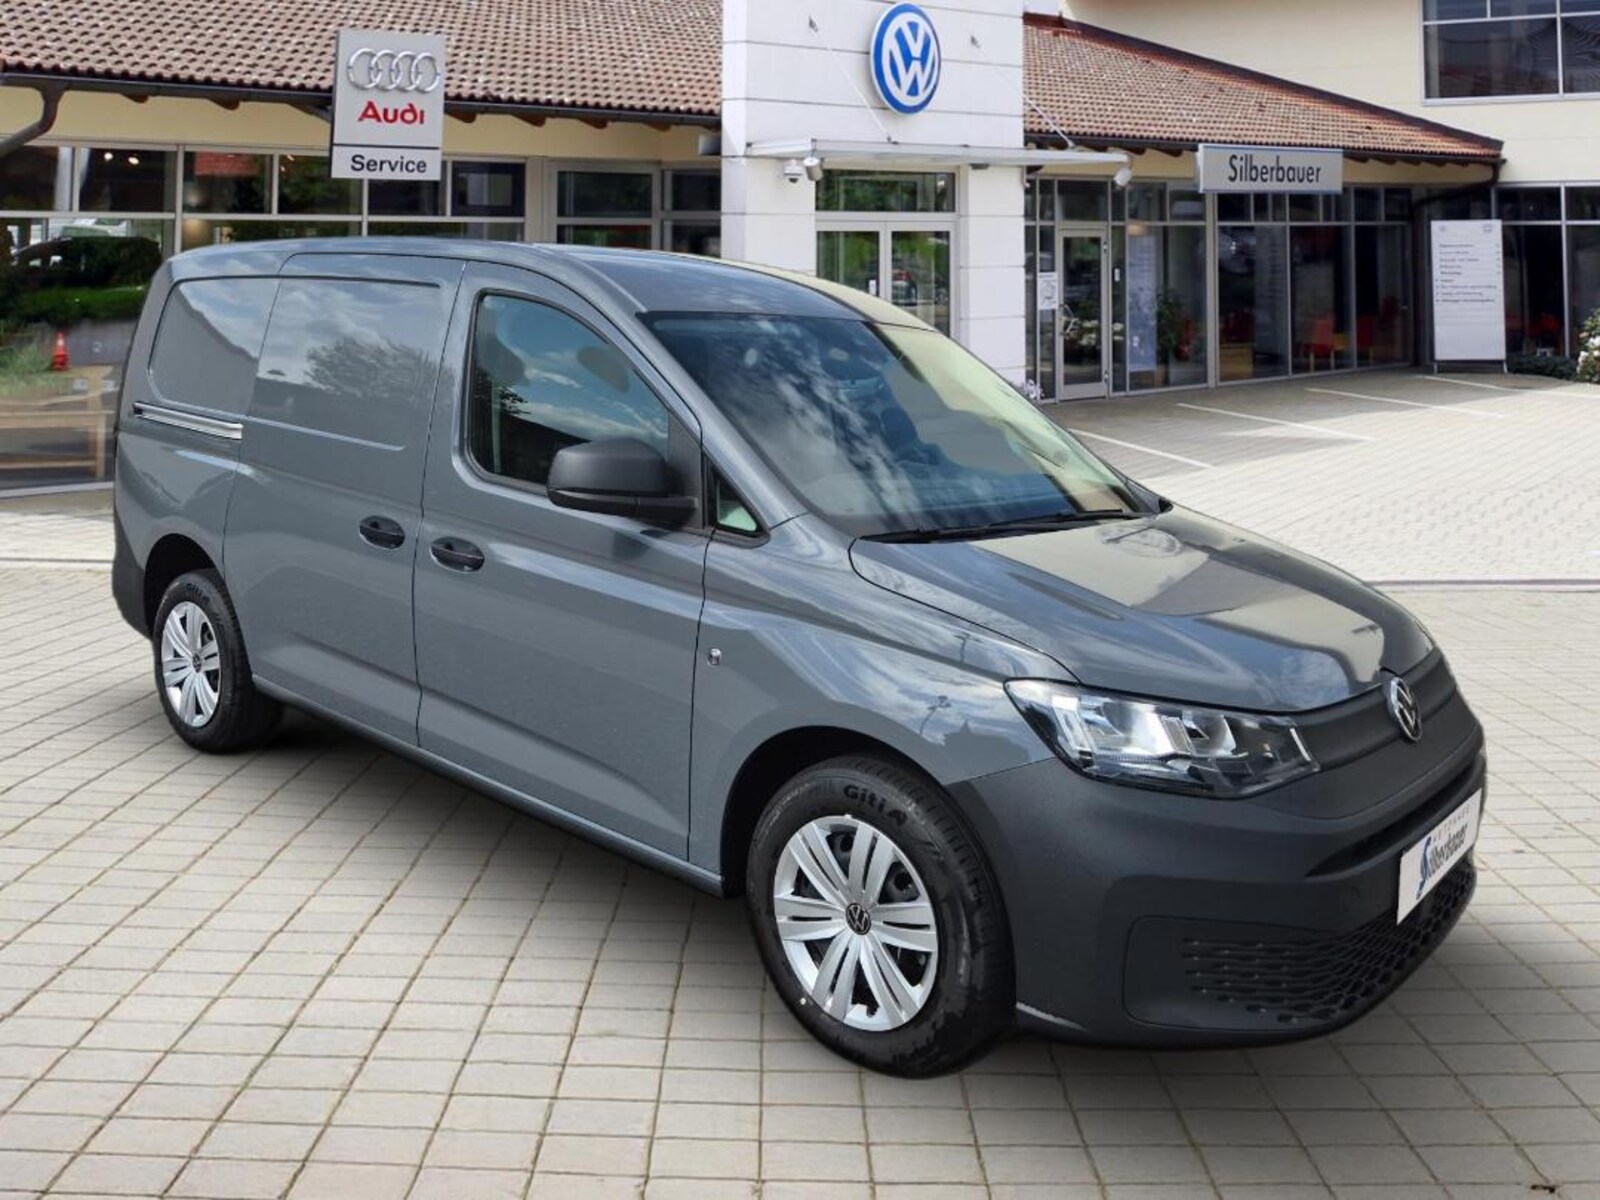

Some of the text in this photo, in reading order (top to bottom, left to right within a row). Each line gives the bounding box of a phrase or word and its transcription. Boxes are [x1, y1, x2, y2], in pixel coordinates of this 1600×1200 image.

[879, 8, 939, 107] VW
[357, 101, 425, 125] Audi
[350, 153, 428, 173] Service
[1228, 154, 1322, 183] Silberbauer
